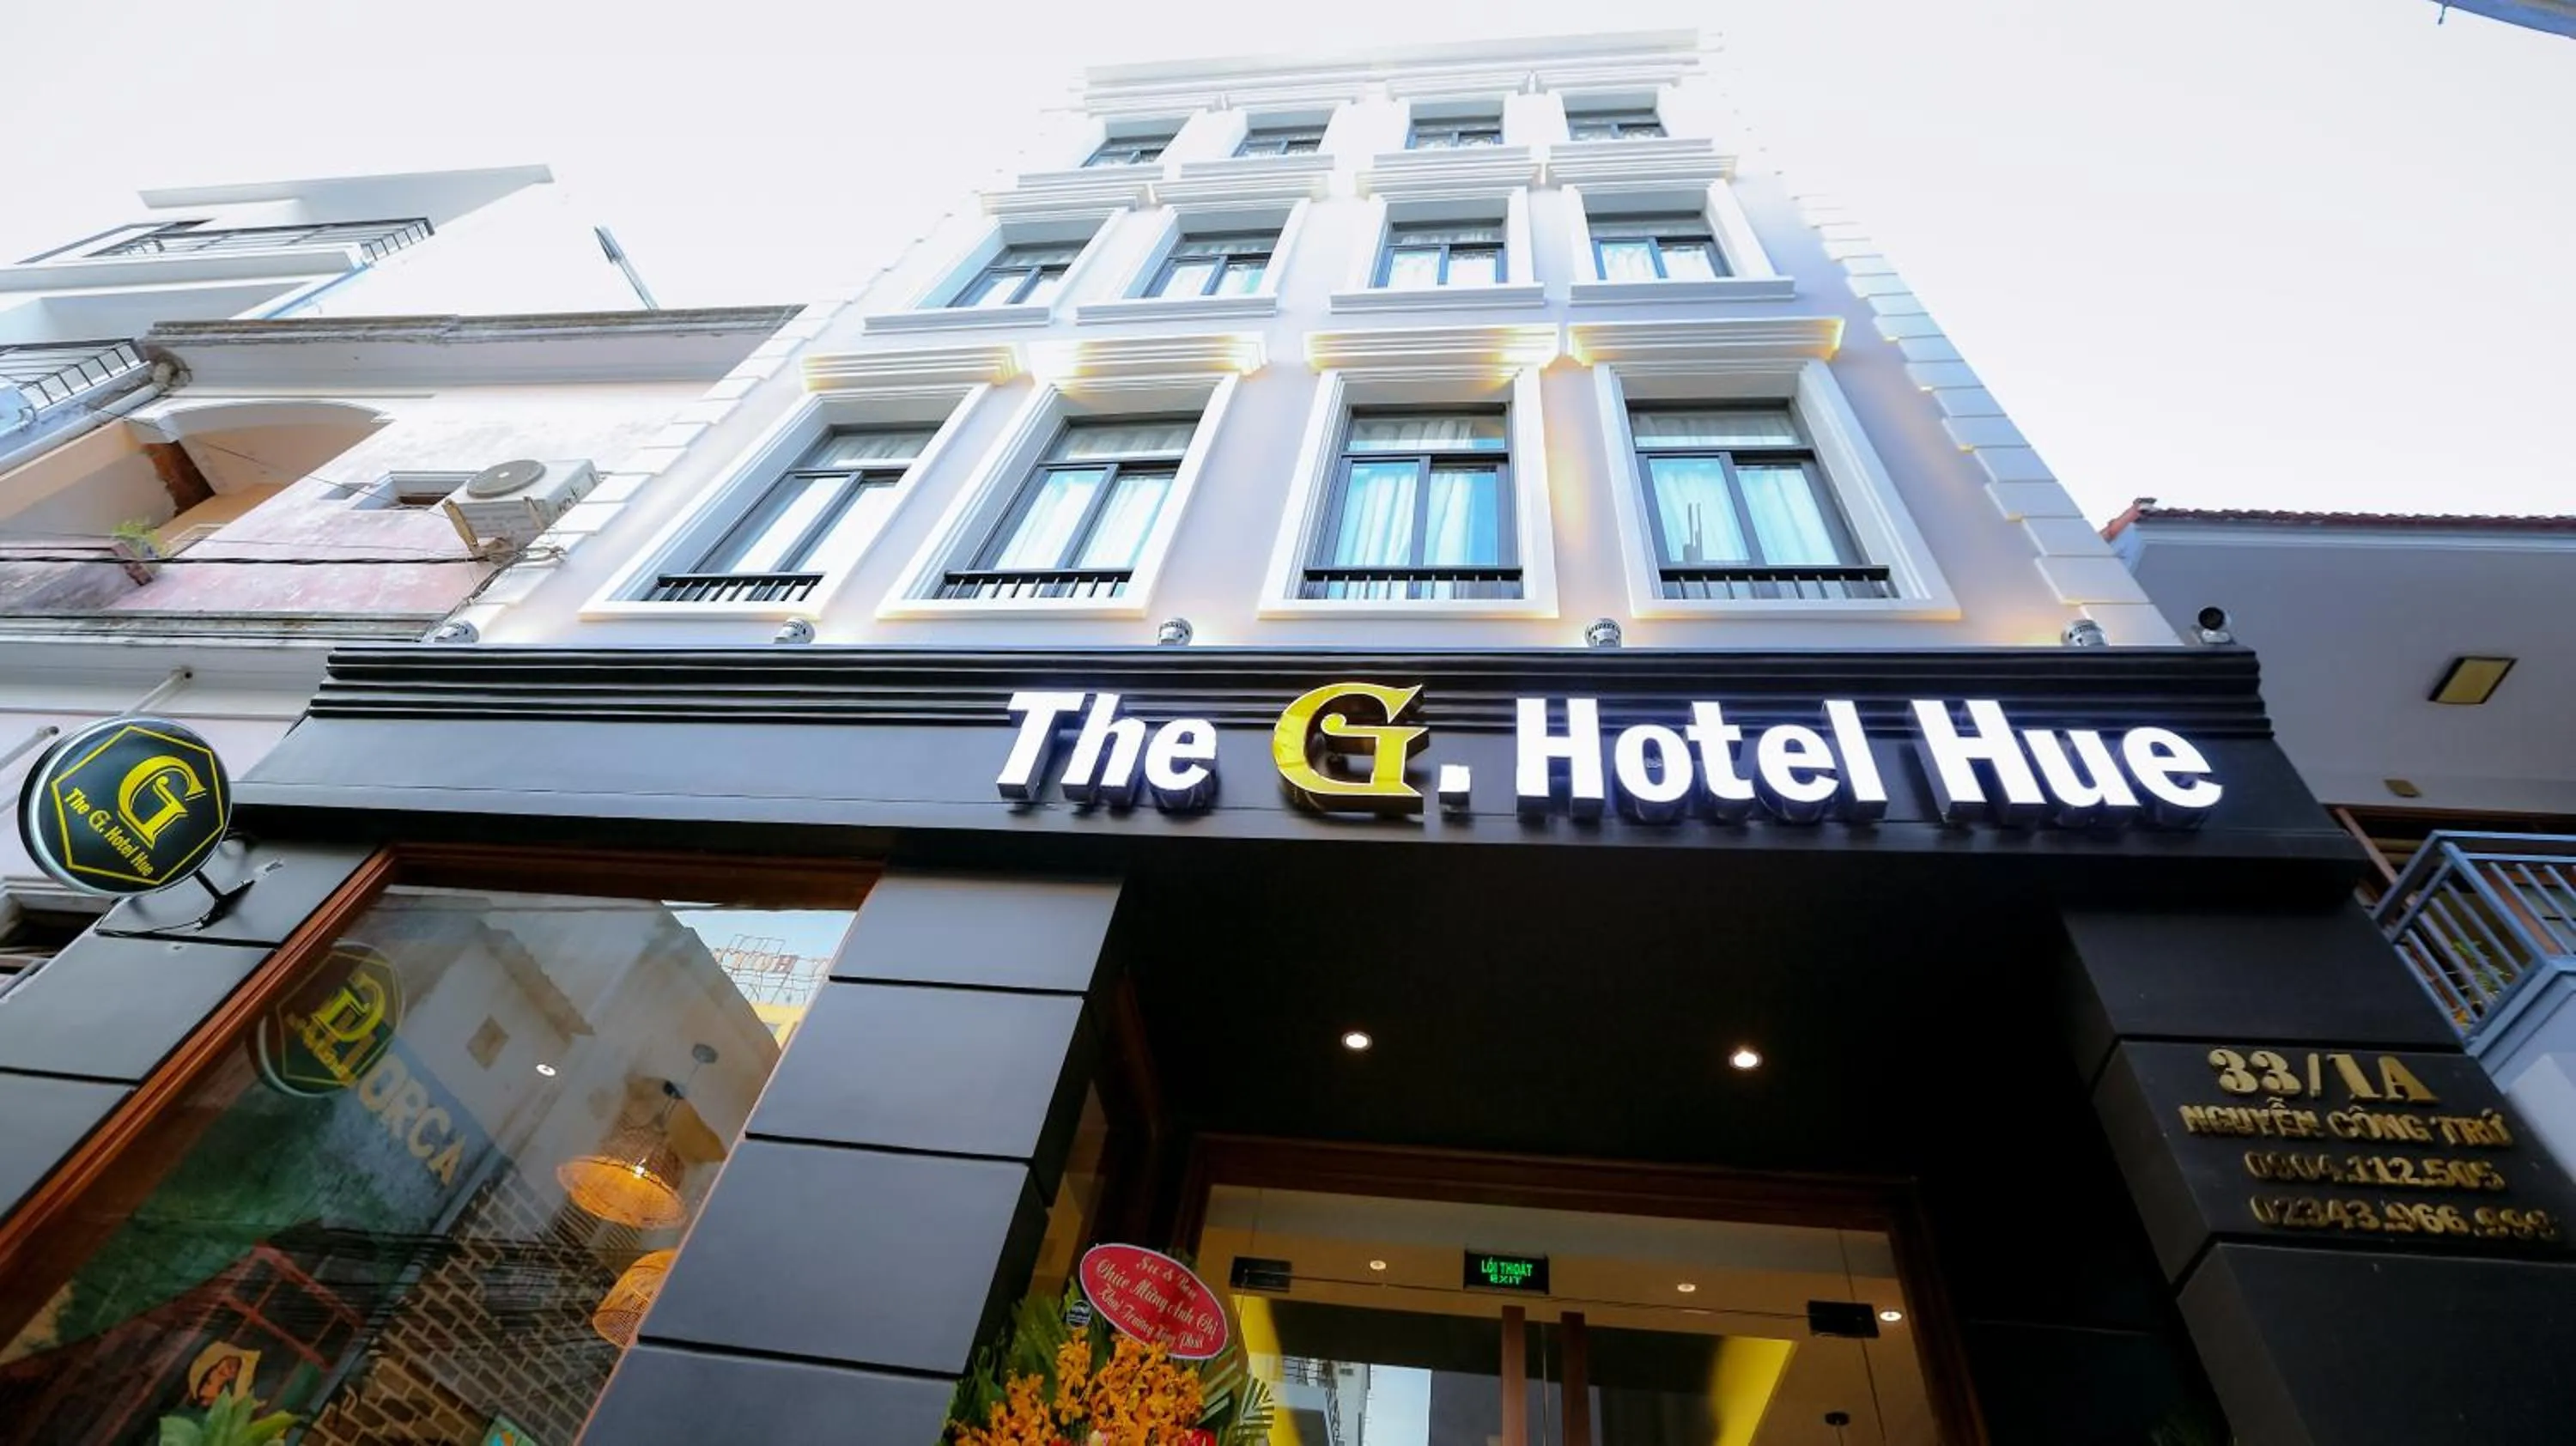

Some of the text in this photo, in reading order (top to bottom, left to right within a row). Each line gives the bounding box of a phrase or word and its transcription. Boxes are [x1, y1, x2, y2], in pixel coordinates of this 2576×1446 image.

[996, 690, 1217, 793] The
[1516, 696, 1887, 804] Hotel
[1909, 699, 2224, 809] Hue
[64, 787, 90, 815] The
[104, 826, 139, 860] Hotel
[132, 853, 155, 878] Hue
[118, 755, 206, 849] G
[2208, 1046, 2441, 1103] 33/1A
[2178, 1096, 2322, 1139] NGUYỄN
[2327, 1104, 2434, 1144] CÔNG
[1490, 1273, 1522, 1285] EXIT
